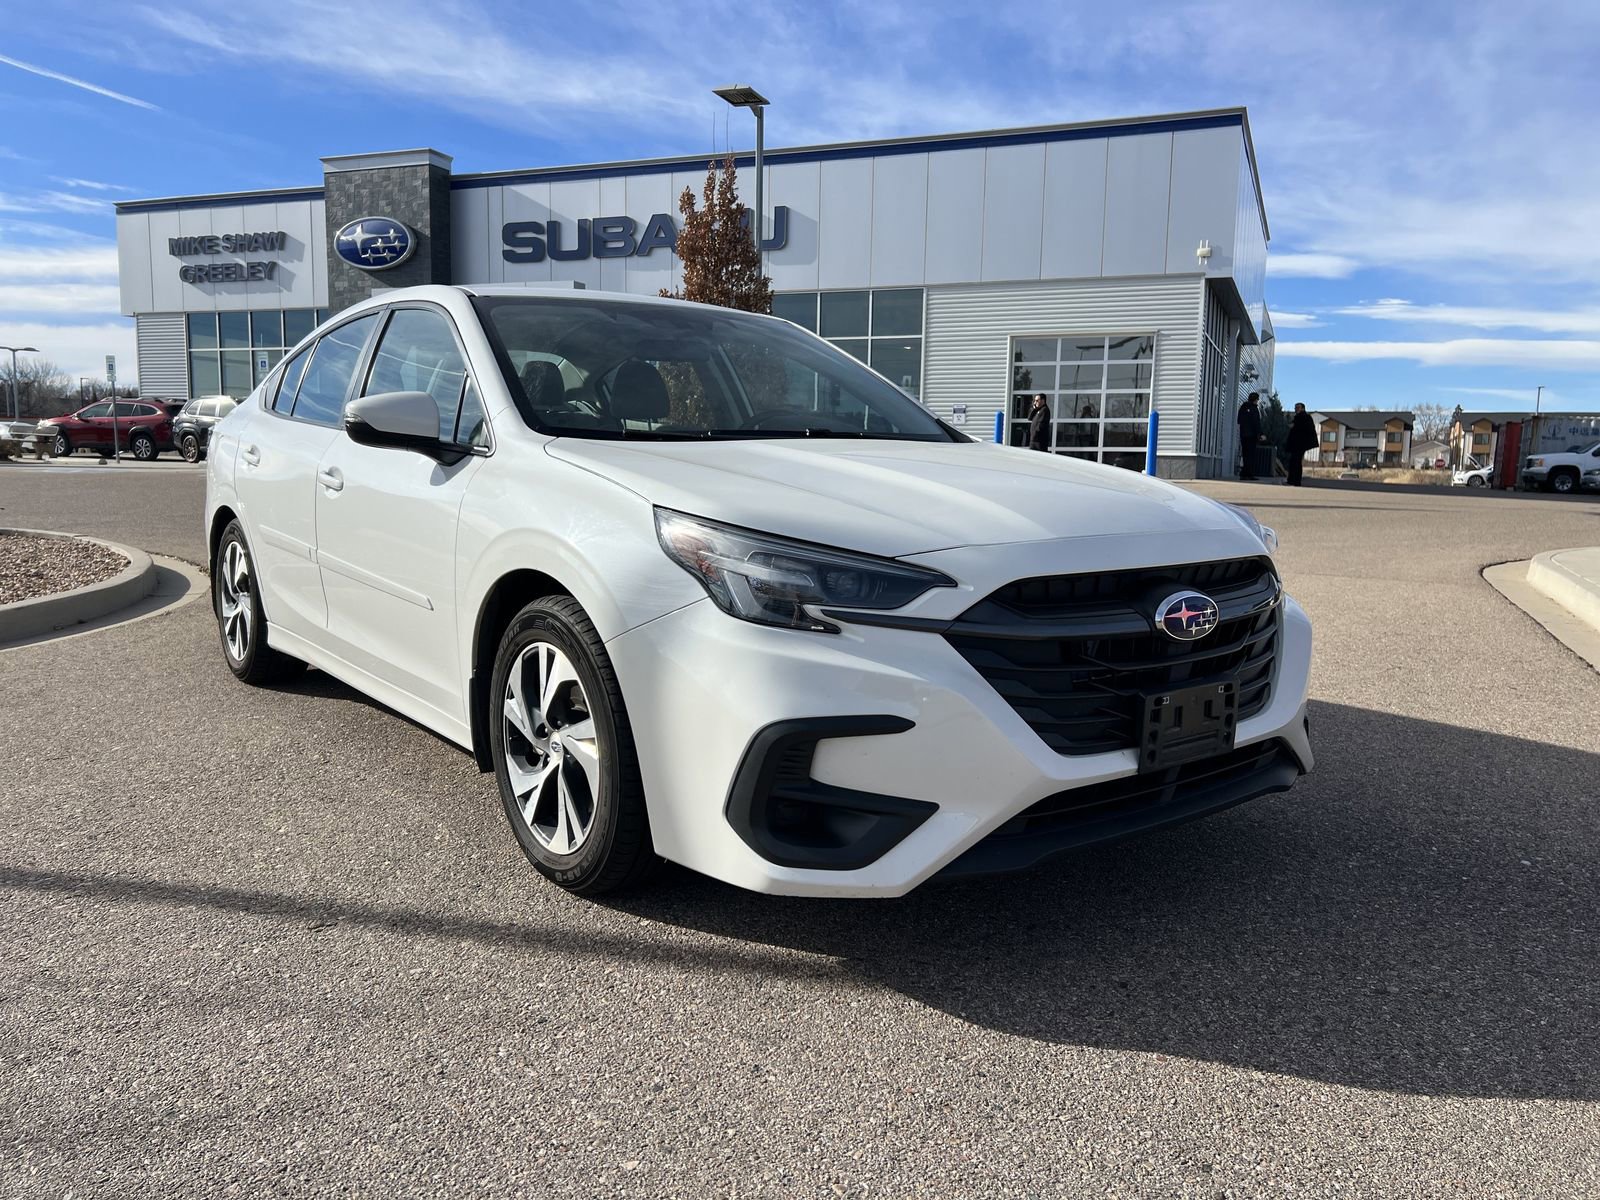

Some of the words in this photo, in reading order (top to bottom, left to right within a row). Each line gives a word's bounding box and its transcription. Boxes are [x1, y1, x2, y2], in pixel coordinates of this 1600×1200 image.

[168, 235, 221, 256] MIKE
[222, 231, 286, 253] SHAW
[502, 205, 788, 263] SUBAU
[179, 261, 278, 283] GREELEY
